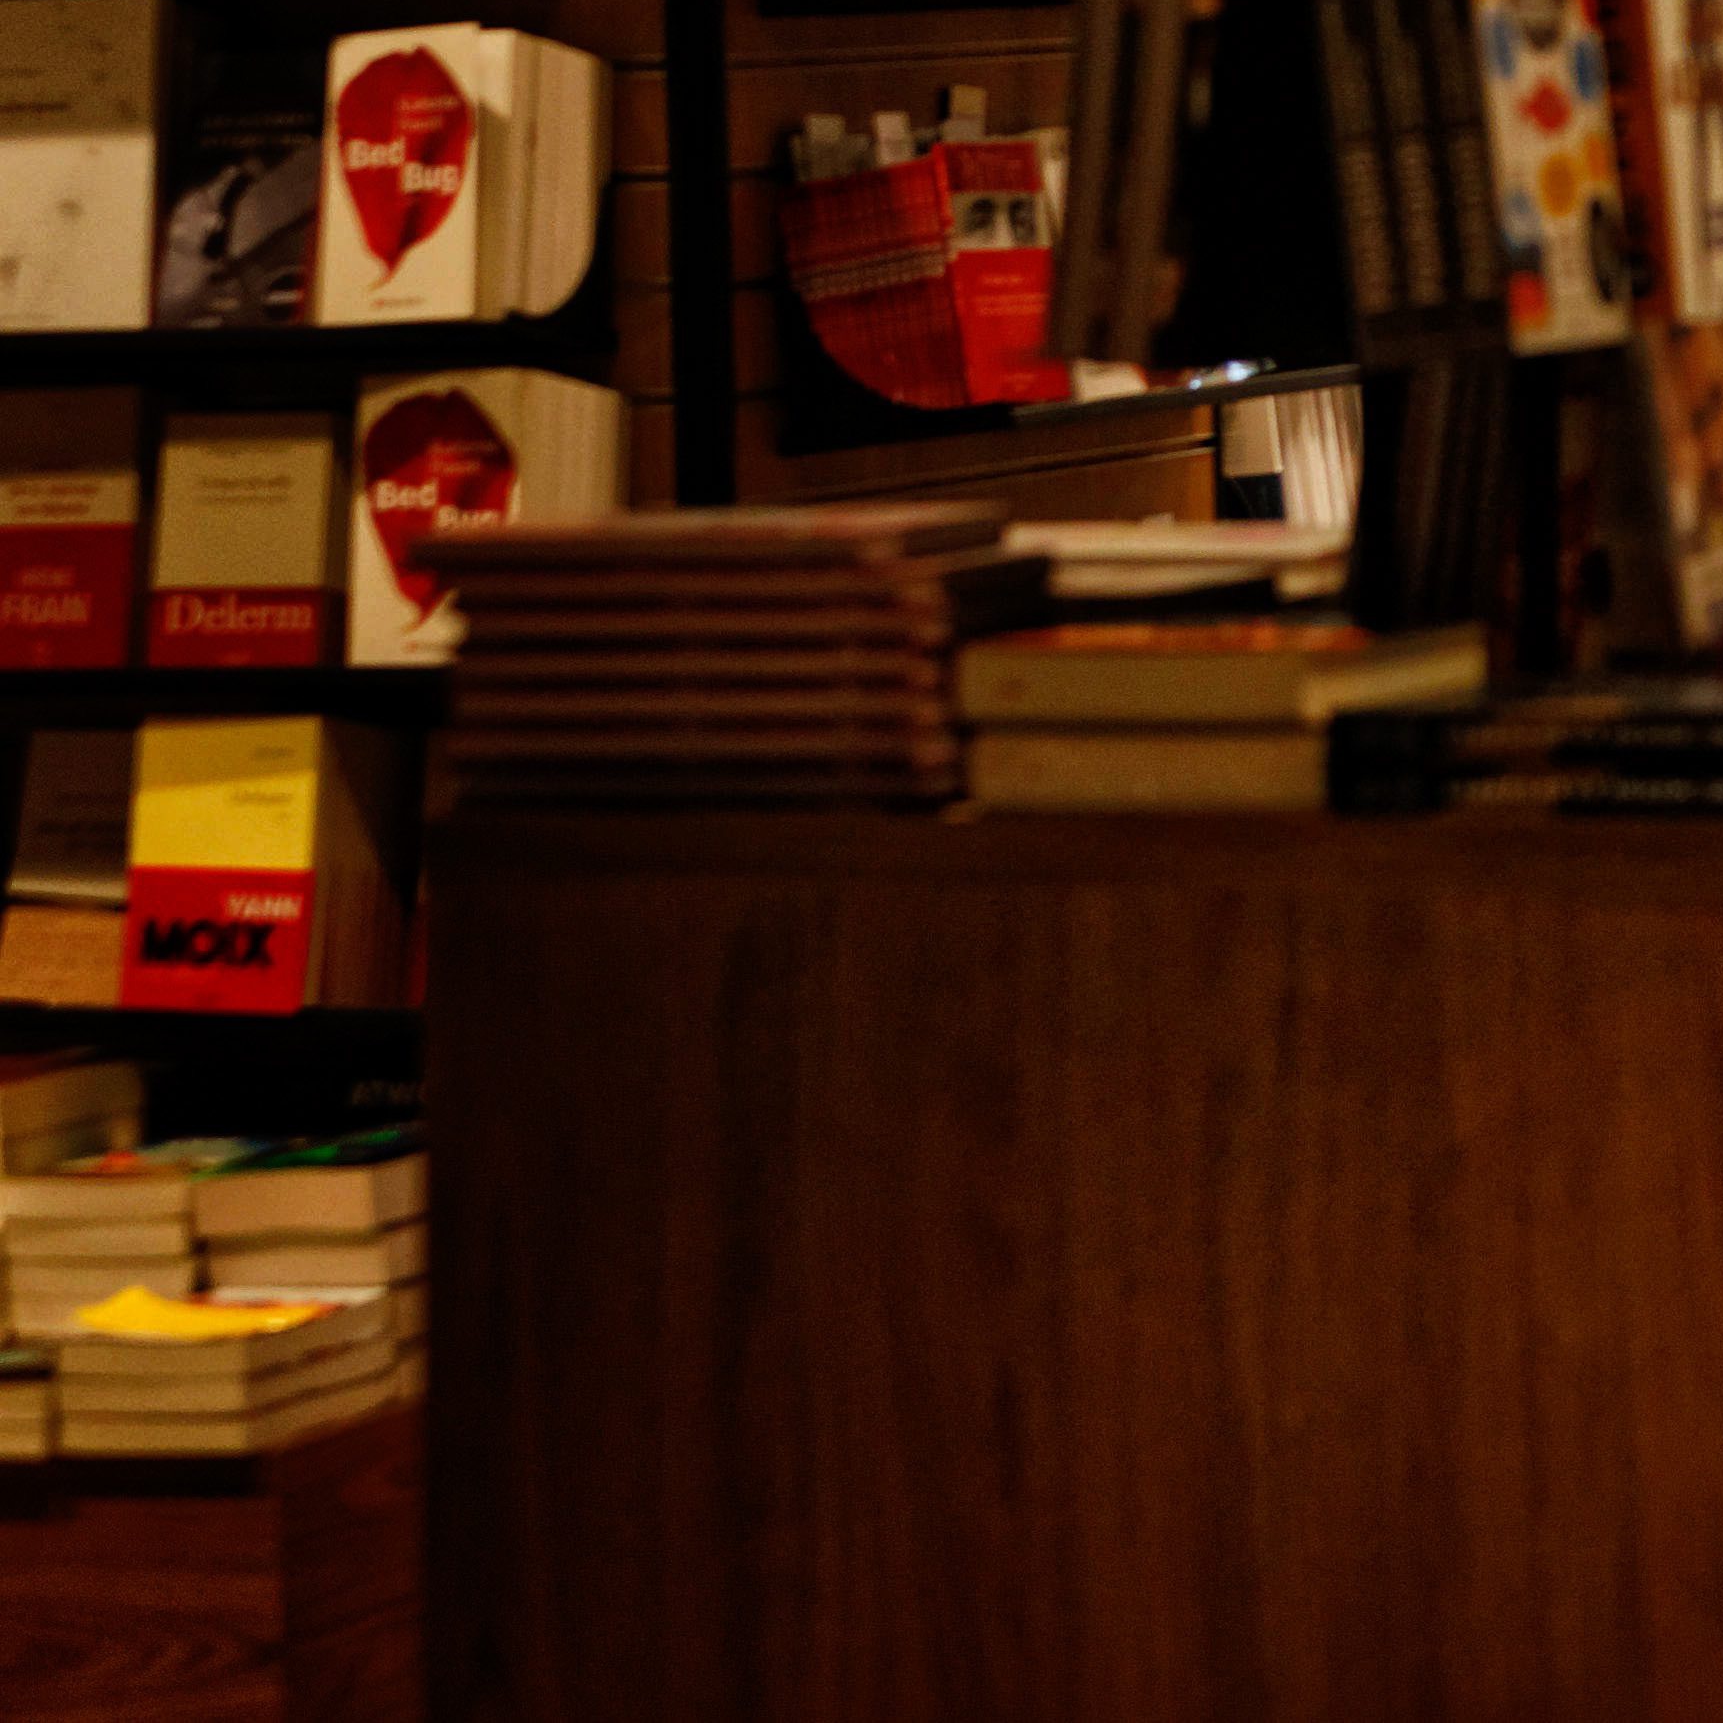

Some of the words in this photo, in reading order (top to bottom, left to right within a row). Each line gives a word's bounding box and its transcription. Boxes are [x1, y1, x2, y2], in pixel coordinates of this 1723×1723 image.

[345, 139, 405, 171] Bed
[402, 162, 459, 196] Bug
[375, 481, 436, 511] Bed
[162, 594, 314, 634] Delerm
[224, 894, 304, 922] YANN
[143, 920, 274, 967] MOIX
